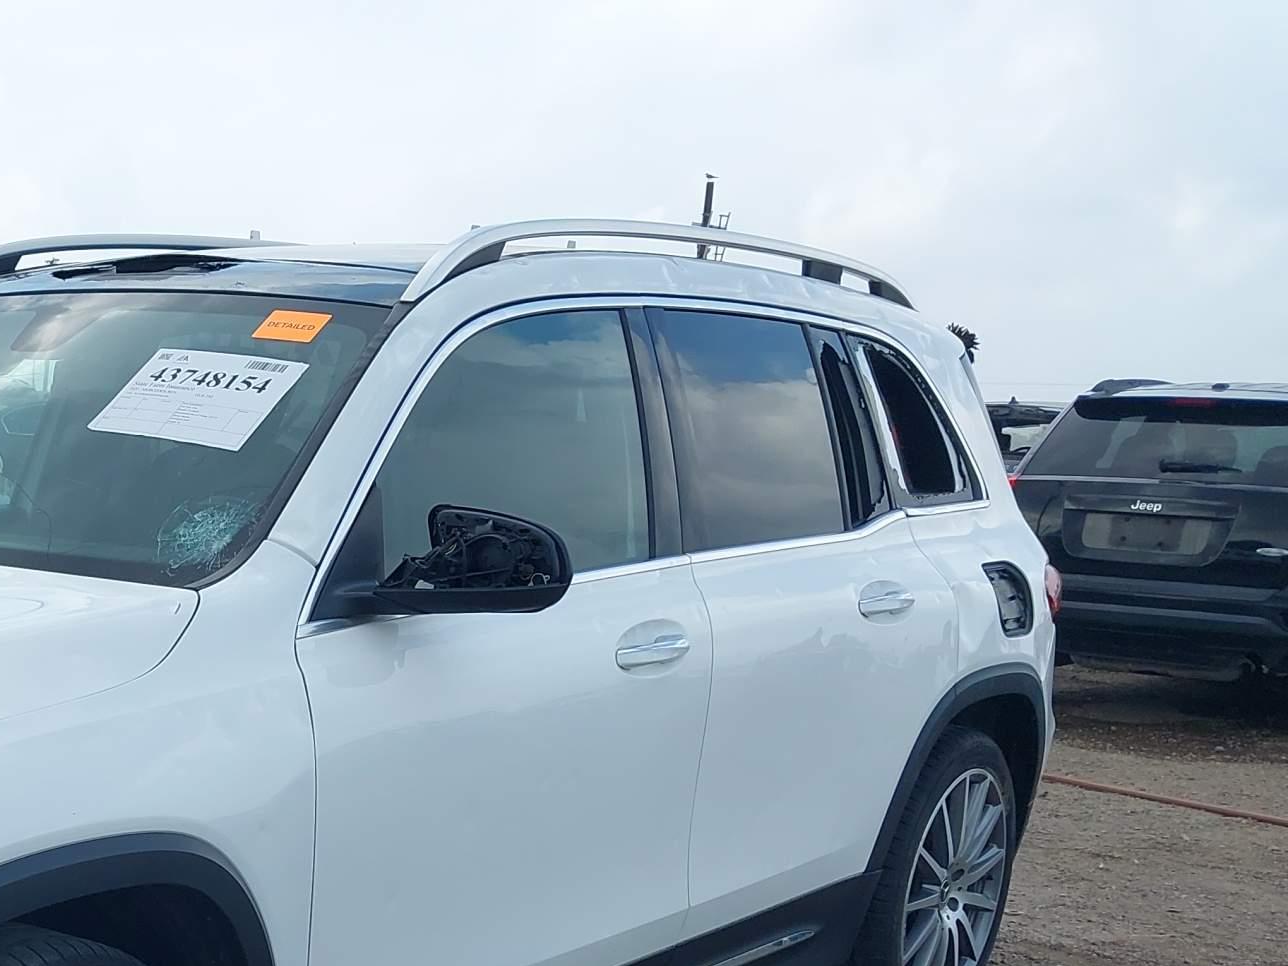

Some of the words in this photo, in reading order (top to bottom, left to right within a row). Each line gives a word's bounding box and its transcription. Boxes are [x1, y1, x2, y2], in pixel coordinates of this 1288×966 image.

[267, 321, 316, 331] DETAILED
[150, 367, 273, 394] 43748154
[1131, 499, 1162, 513] Jeep
